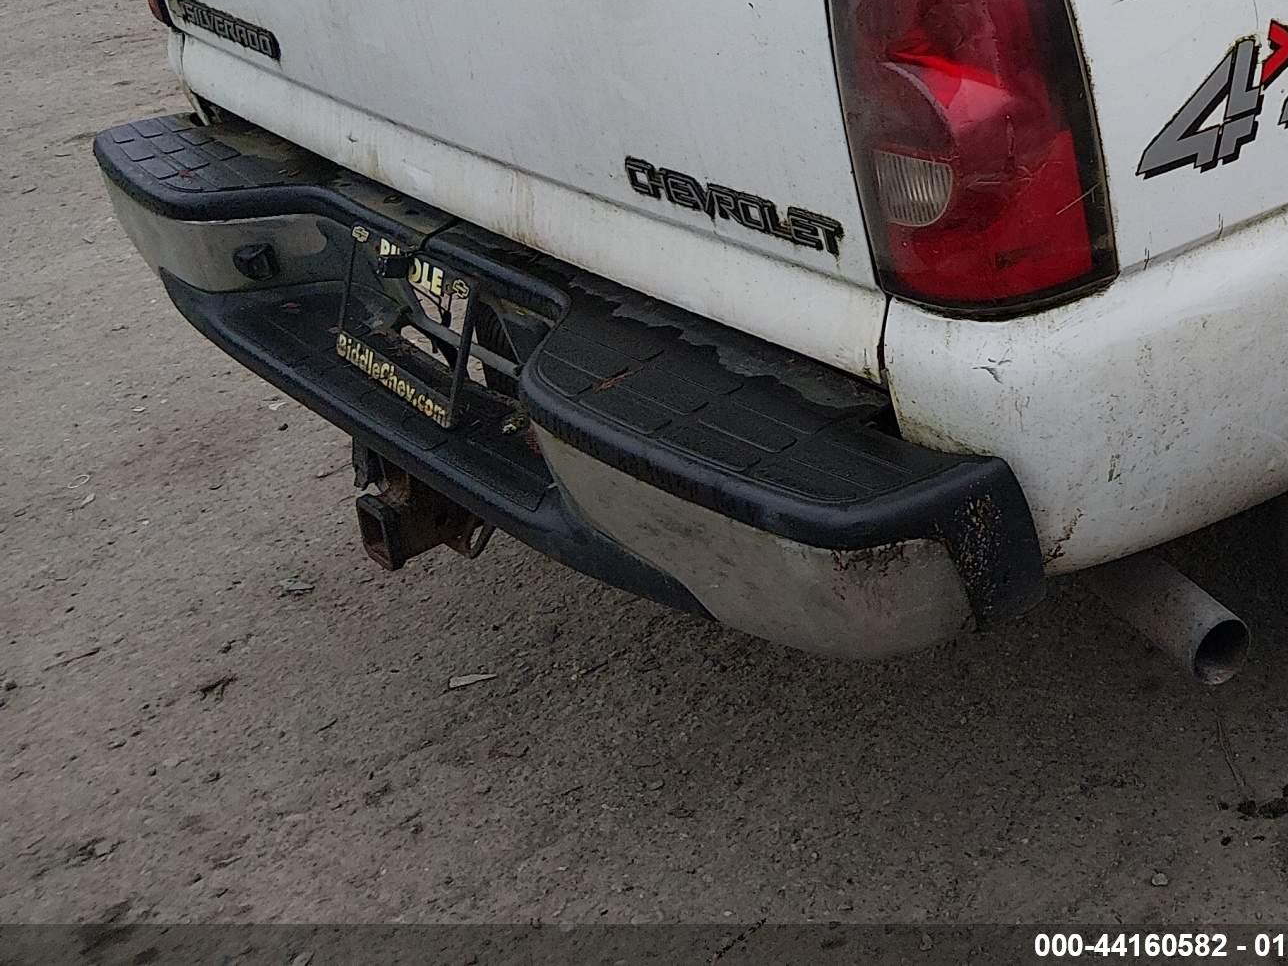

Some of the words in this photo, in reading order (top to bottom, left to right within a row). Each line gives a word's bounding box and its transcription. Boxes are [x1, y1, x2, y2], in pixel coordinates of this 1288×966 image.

[183, 0, 275, 58] SILVERADO
[625, 155, 844, 257] CHEVROLET
[379, 237, 444, 297] BDLE
[335, 333, 451, 428] BiddleChev.com
